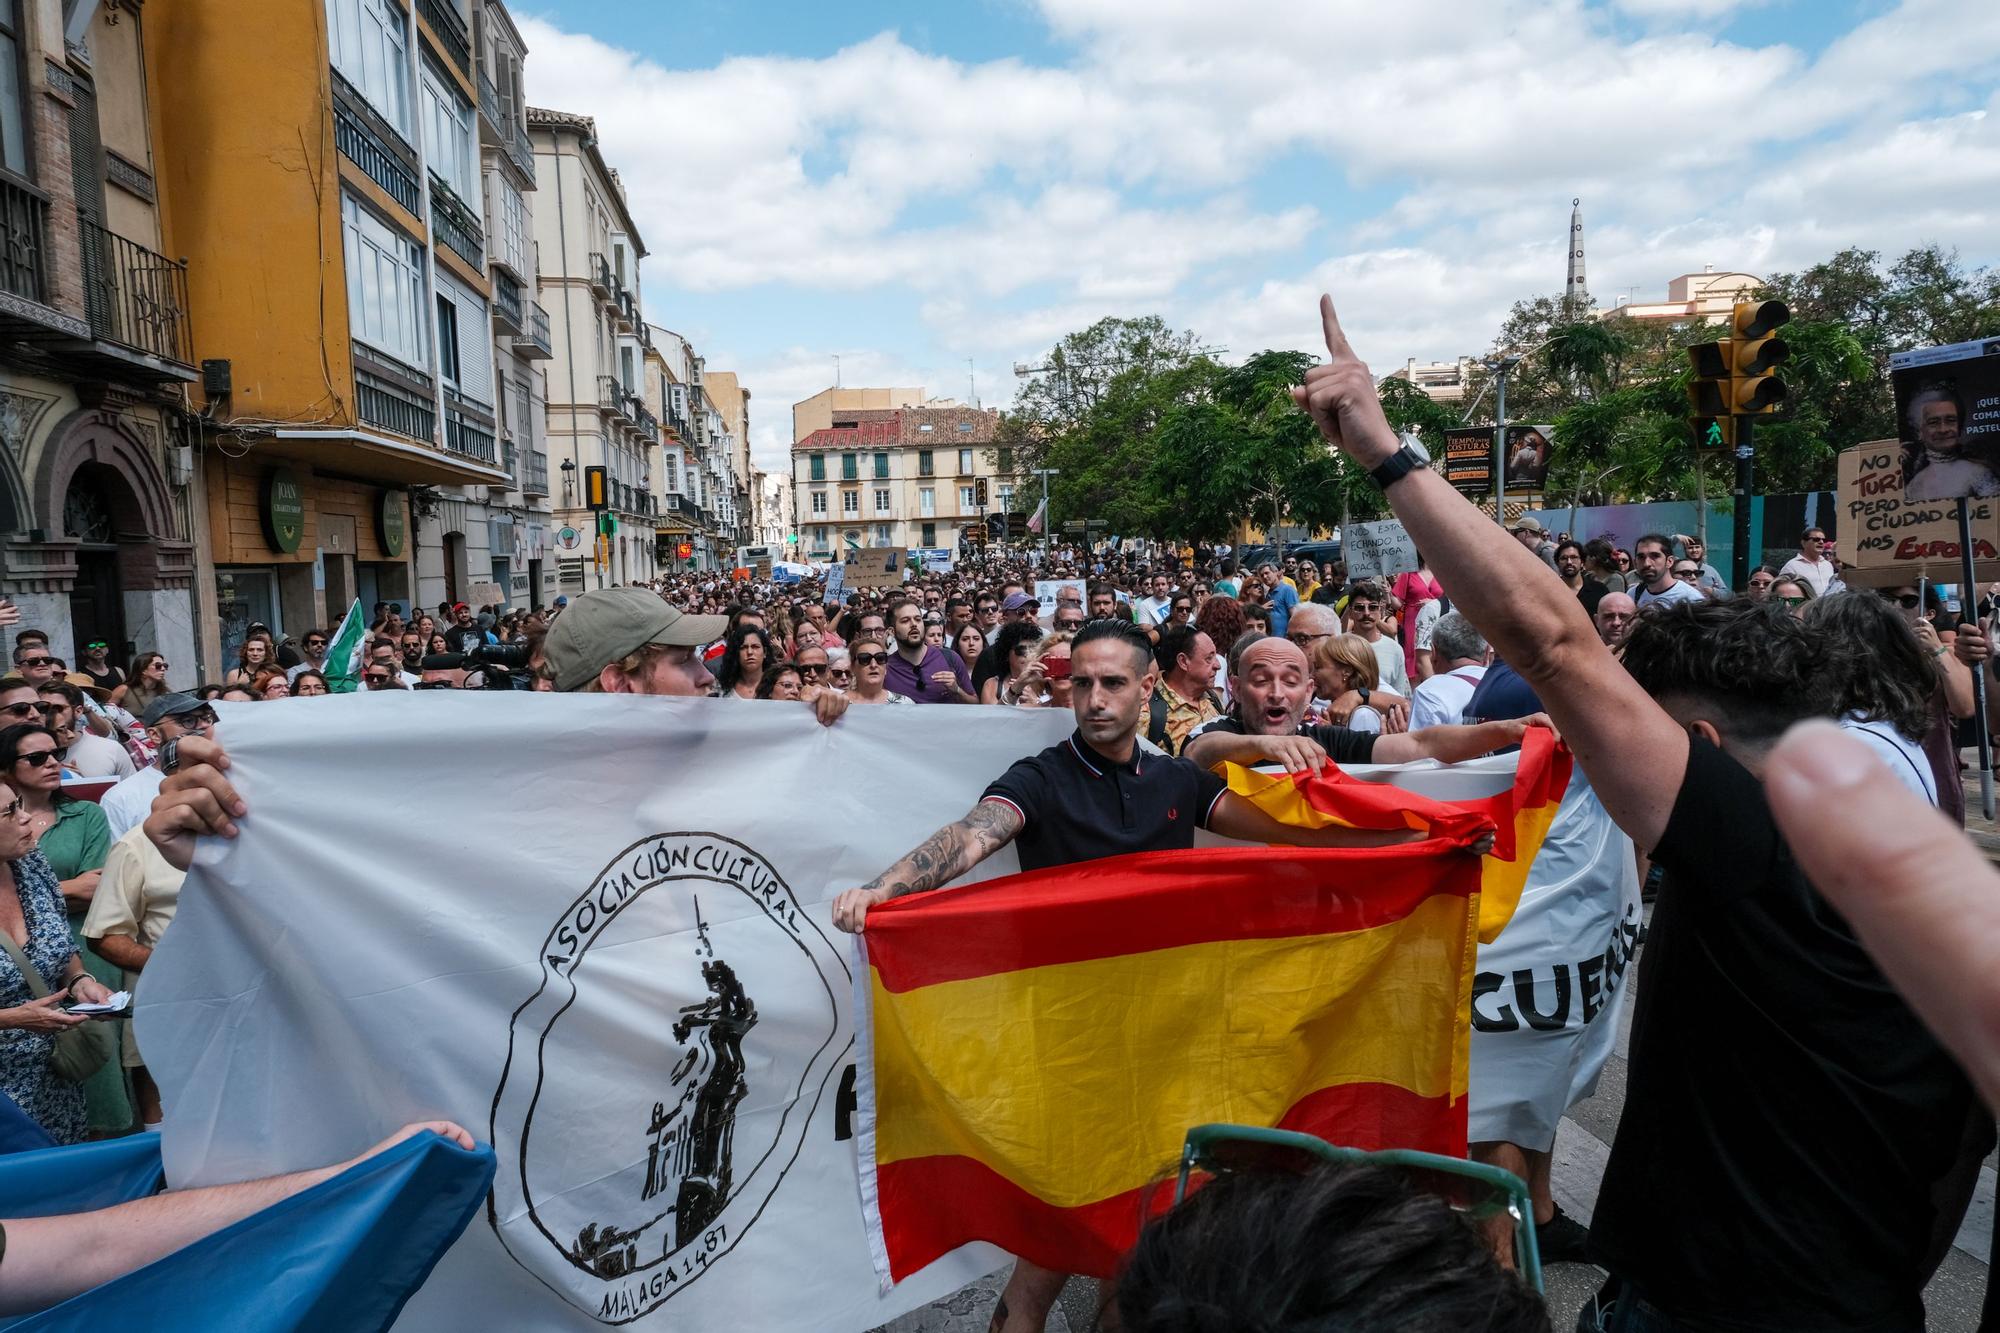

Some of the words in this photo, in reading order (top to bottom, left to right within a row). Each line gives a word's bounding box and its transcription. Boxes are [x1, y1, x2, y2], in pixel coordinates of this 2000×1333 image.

[1972, 410, 2000, 420] COMA
[1447, 437, 1475, 445] TIEMPO
[1447, 442, 1490, 451] COSTURAS
[1859, 454, 1890, 472] NO
[1851, 469, 1903, 497] TURI
[1848, 499, 1899, 520] PERO
[1350, 537, 1391, 551] ECHANDO
[1396, 534, 1408, 542] DE
[1856, 534, 1894, 552] NOS
[1352, 562, 1380, 573] PACO
[547, 840, 690, 978] ASOCIACIÓN
[693, 844, 803, 934] CULTURAL
[597, 1265, 679, 1319] MÁLAGA
[682, 1224, 728, 1278] 1487
